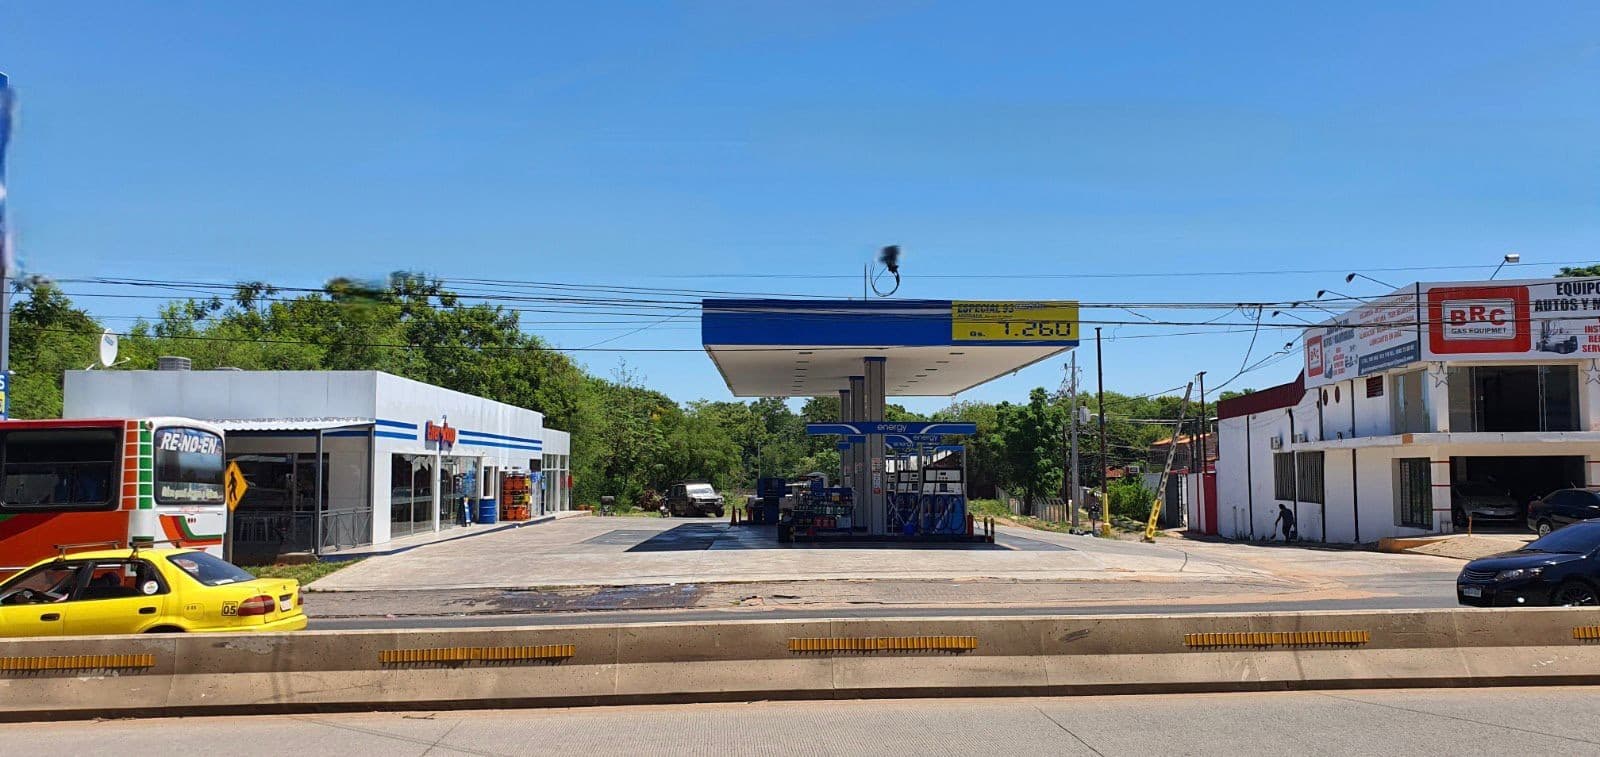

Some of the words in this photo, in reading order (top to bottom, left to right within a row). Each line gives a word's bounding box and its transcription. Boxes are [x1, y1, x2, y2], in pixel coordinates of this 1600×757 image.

[957, 303, 1000, 313] ESPECIAL
[1002, 303, 1014, 313] 93
[1535, 298, 1577, 311] AUTOS
[1450, 305, 1505, 326] BRC
[877, 424, 908, 432] energy
[160, 432, 217, 454] RE-NO-EN
[223, 605, 236, 614] 05
